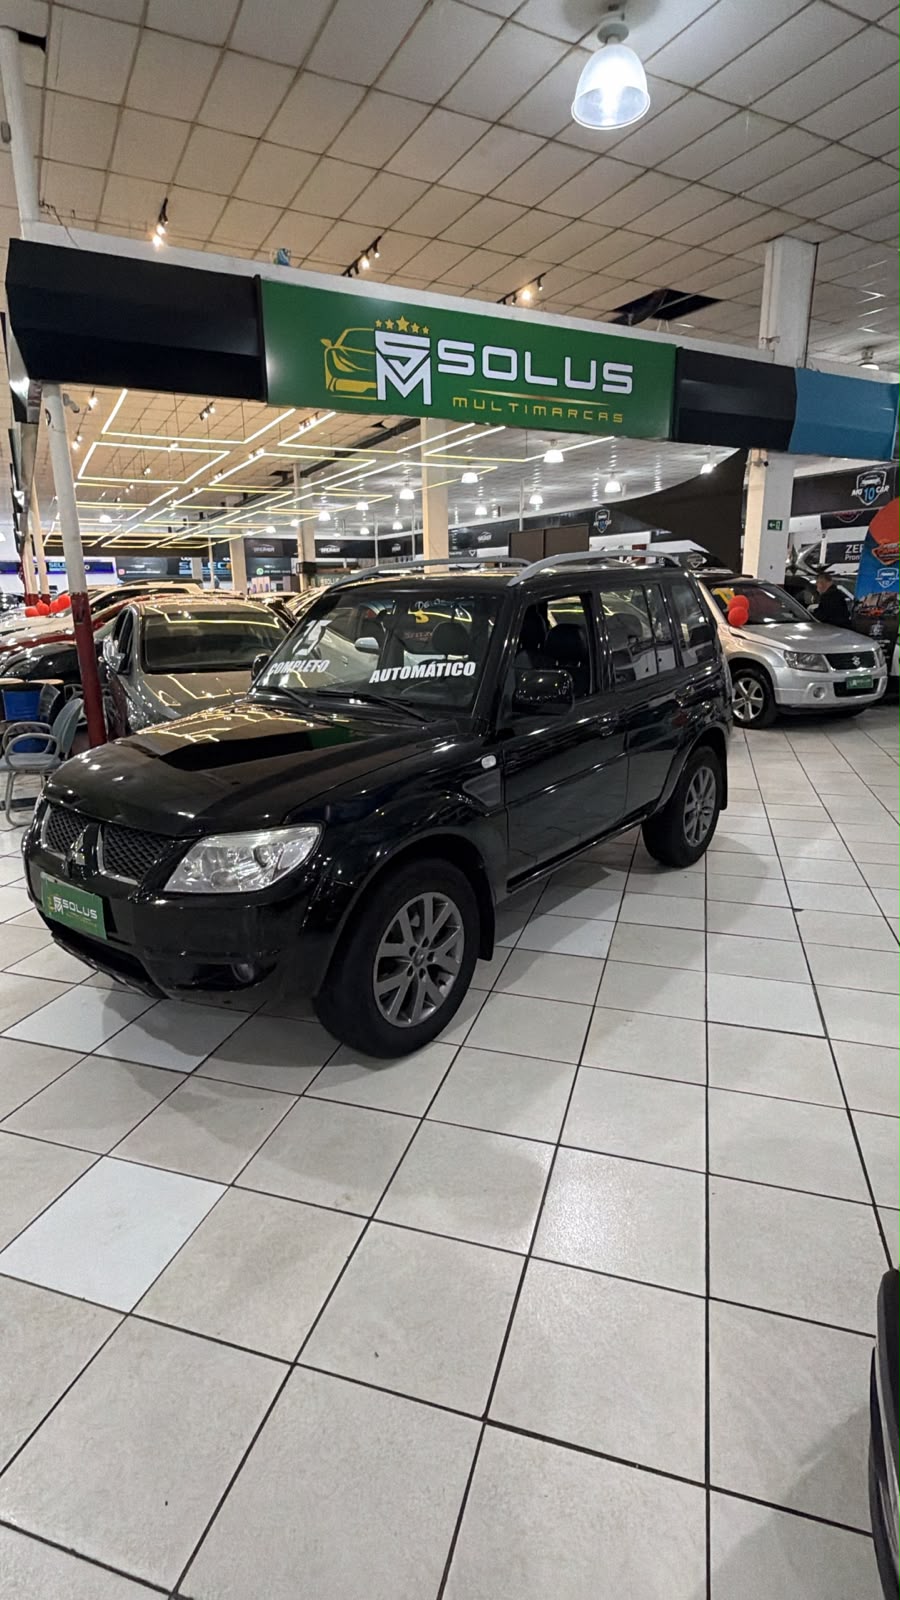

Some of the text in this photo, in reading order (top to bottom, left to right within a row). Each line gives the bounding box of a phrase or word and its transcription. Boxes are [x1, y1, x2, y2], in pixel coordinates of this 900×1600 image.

[437, 339, 633, 395] SOLUS
[453, 397, 623, 423] MULTIMARCAS
[864, 487, 875, 501] 10
[876, 485, 890, 493] CAR
[268, 660, 330, 675] COMPLETO
[369, 661, 476, 683] AUTOMÁTICO
[62, 899, 98, 919] SOLUS
